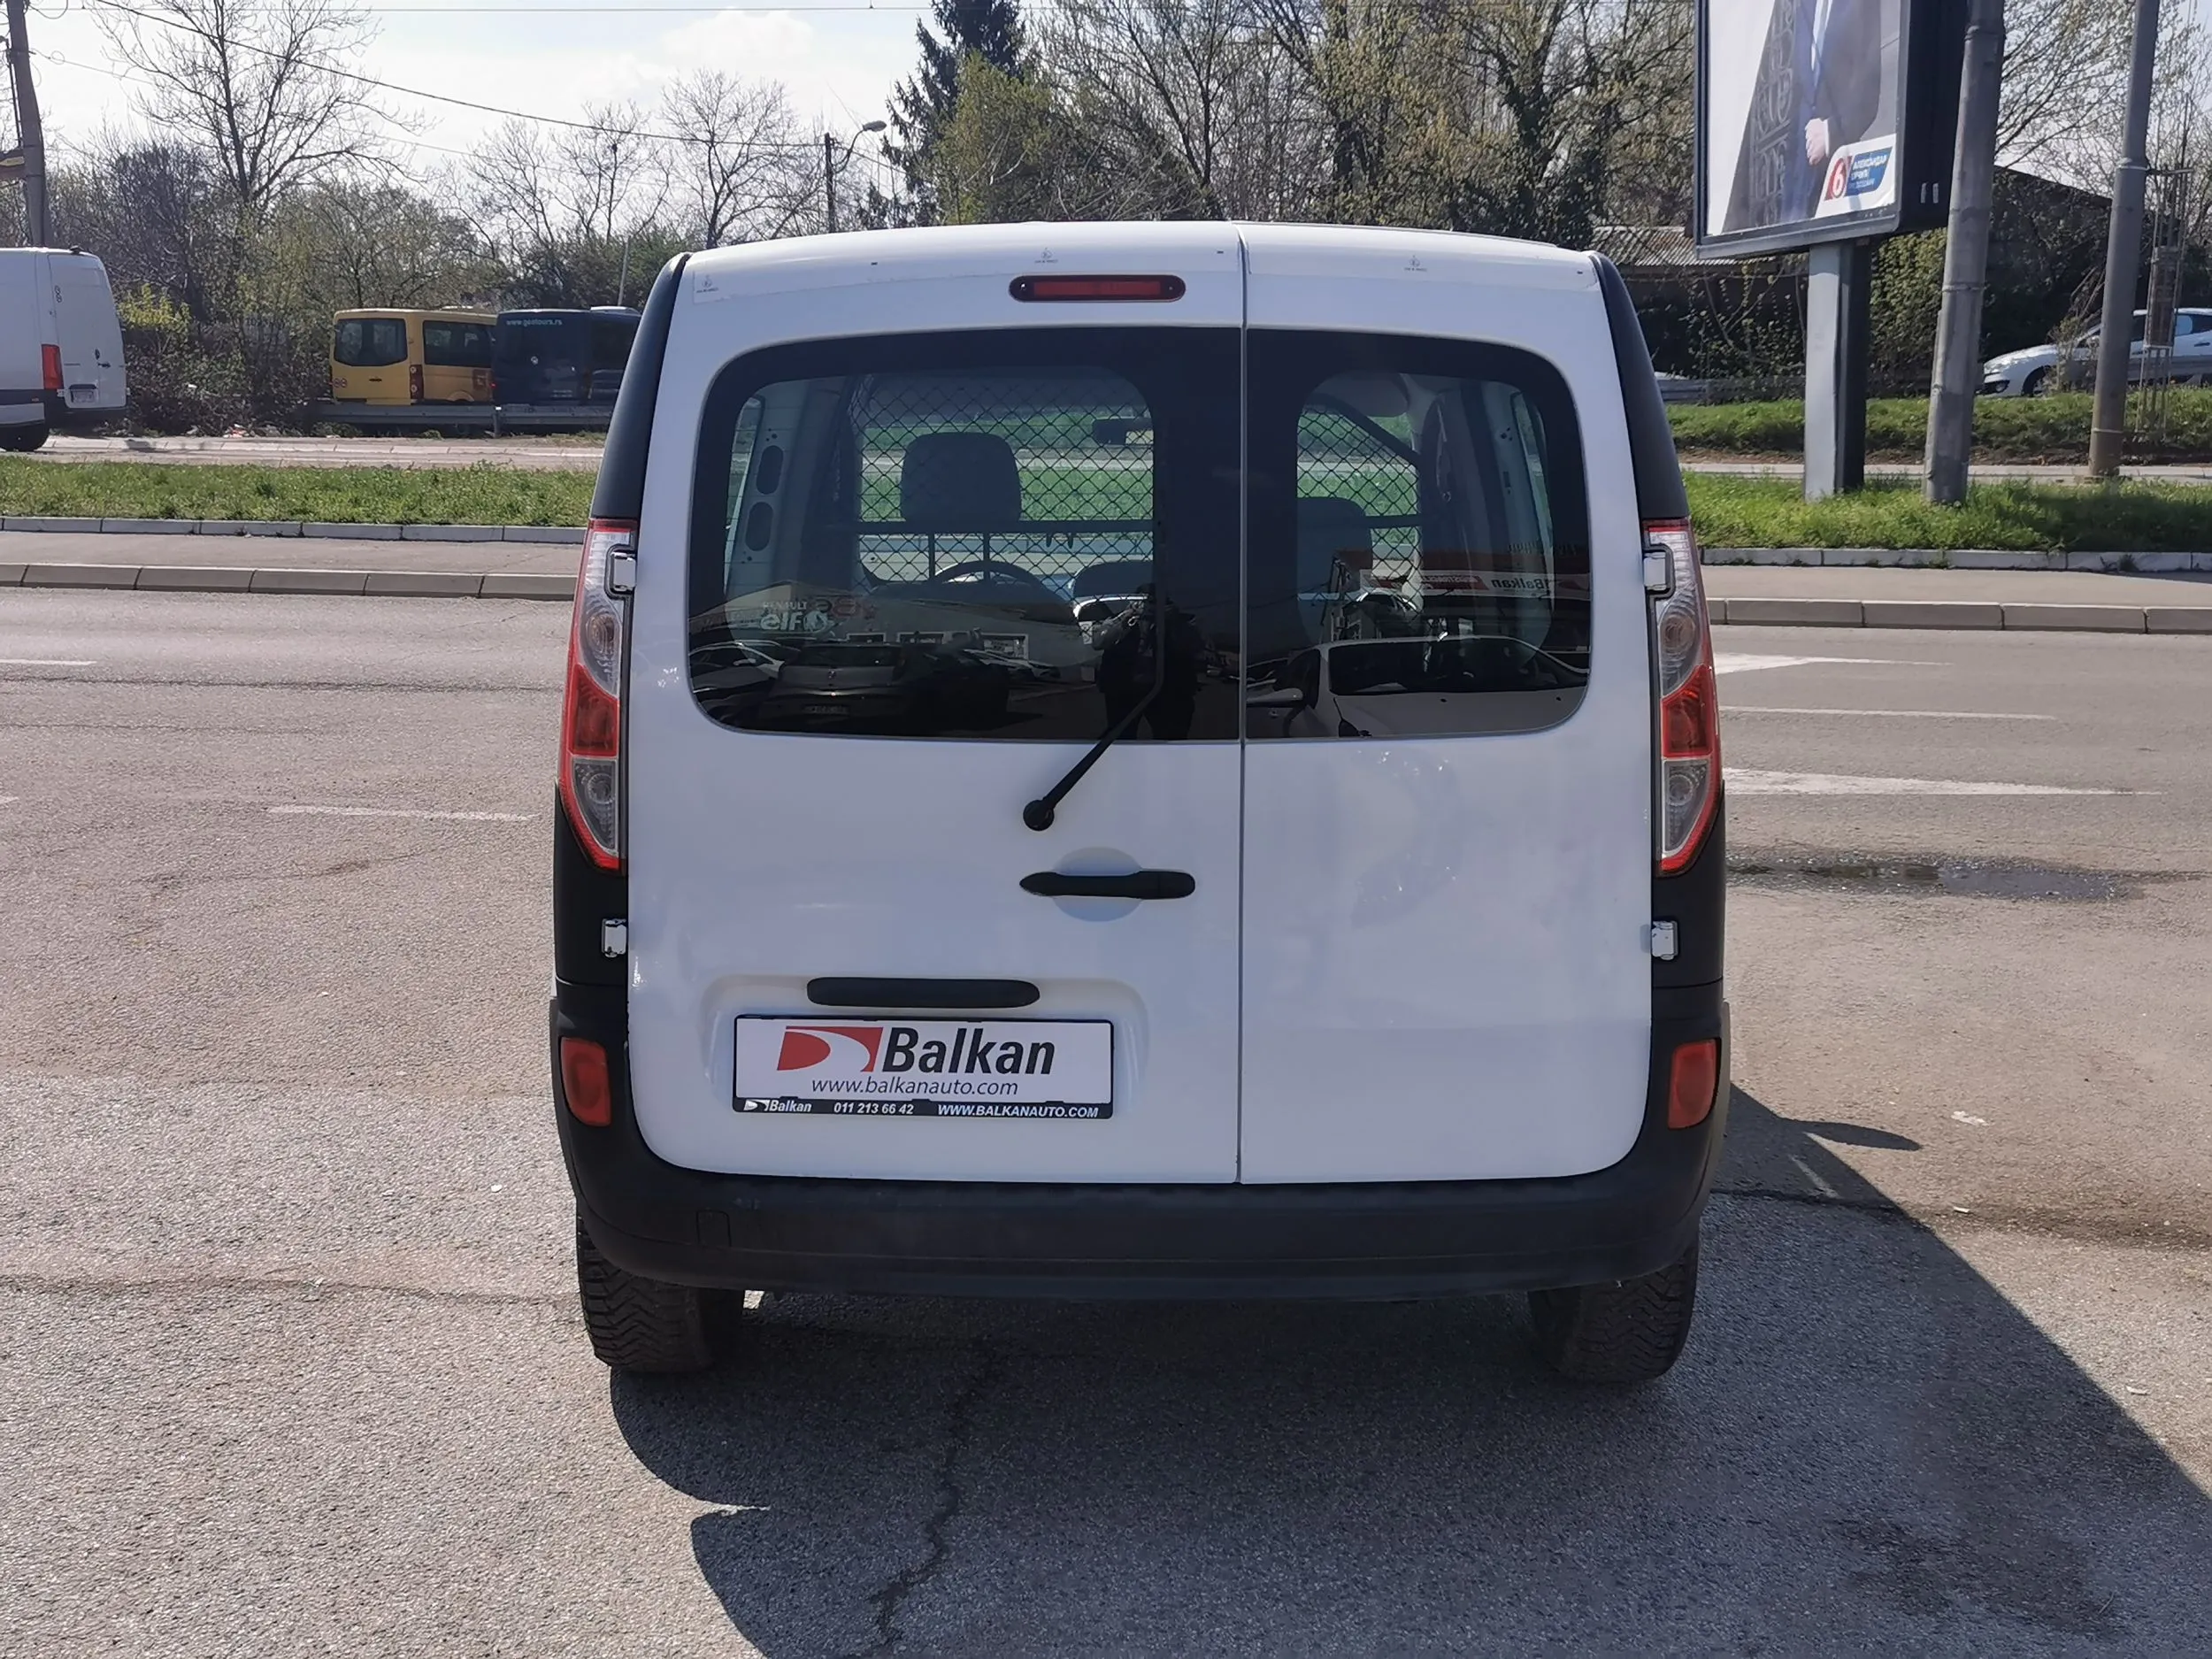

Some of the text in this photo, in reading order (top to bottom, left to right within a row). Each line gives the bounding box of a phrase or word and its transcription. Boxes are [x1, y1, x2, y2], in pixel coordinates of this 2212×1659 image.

[1832, 159, 1845, 196] 6
[882, 1027, 1056, 1074] Balkan
[811, 1076, 1018, 1095] www.balkanauto.com
[770, 1100, 1099, 1118] Balkan 011 213 66 42 WWW.BALKANAUTO.COM
